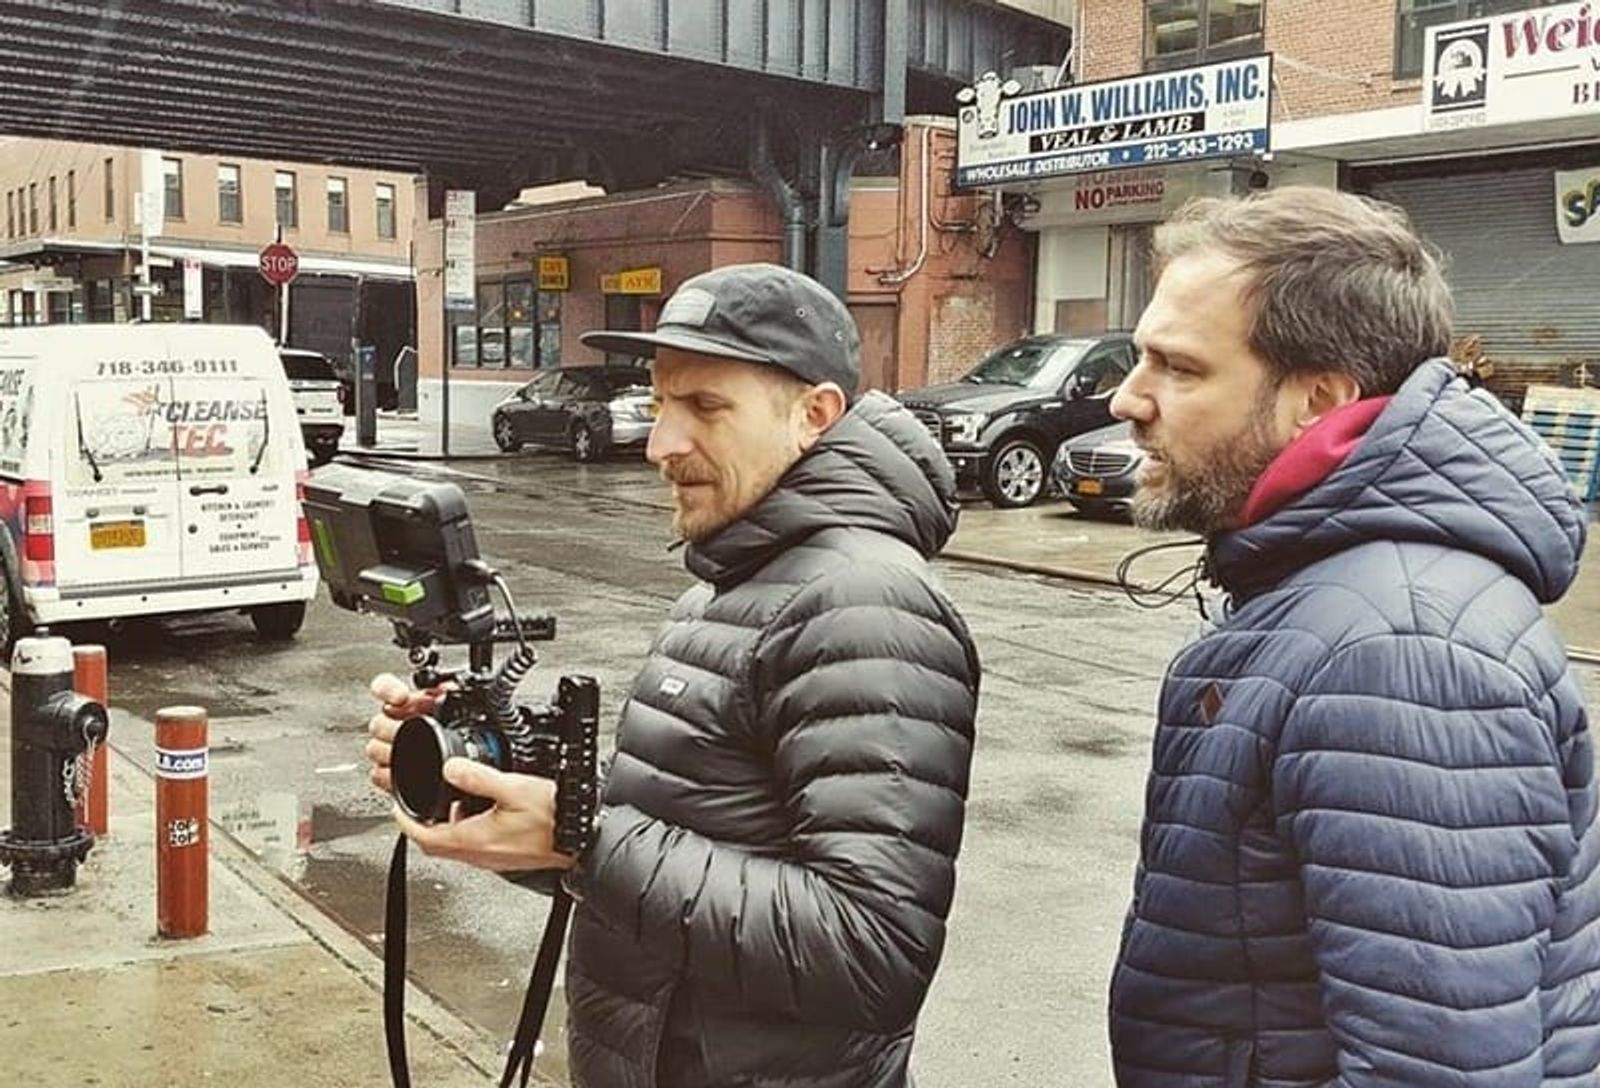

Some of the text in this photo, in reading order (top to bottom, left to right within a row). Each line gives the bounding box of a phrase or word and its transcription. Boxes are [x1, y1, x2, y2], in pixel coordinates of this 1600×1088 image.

[1503, 3, 1600, 58] Wei
[1007, 95, 1056, 135] JOHN
[1061, 90, 1087, 126] W.
[1091, 73, 1209, 121] WILLIAMS,
[1216, 64, 1265, 104] INC.
[1041, 116, 1194, 151] VEAL & LAMB
[966, 131, 1254, 181] WHOLESALE DISTRIBUTOR 212-243-1293
[1075, 187, 1105, 210] NO
[1106, 181, 1164, 199] PARKING
[261, 254, 298, 271] STOP
[97, 359, 238, 376] 718-346-9111
[166, 399, 268, 423] CLEANSE
[168, 423, 228, 453] TEC
